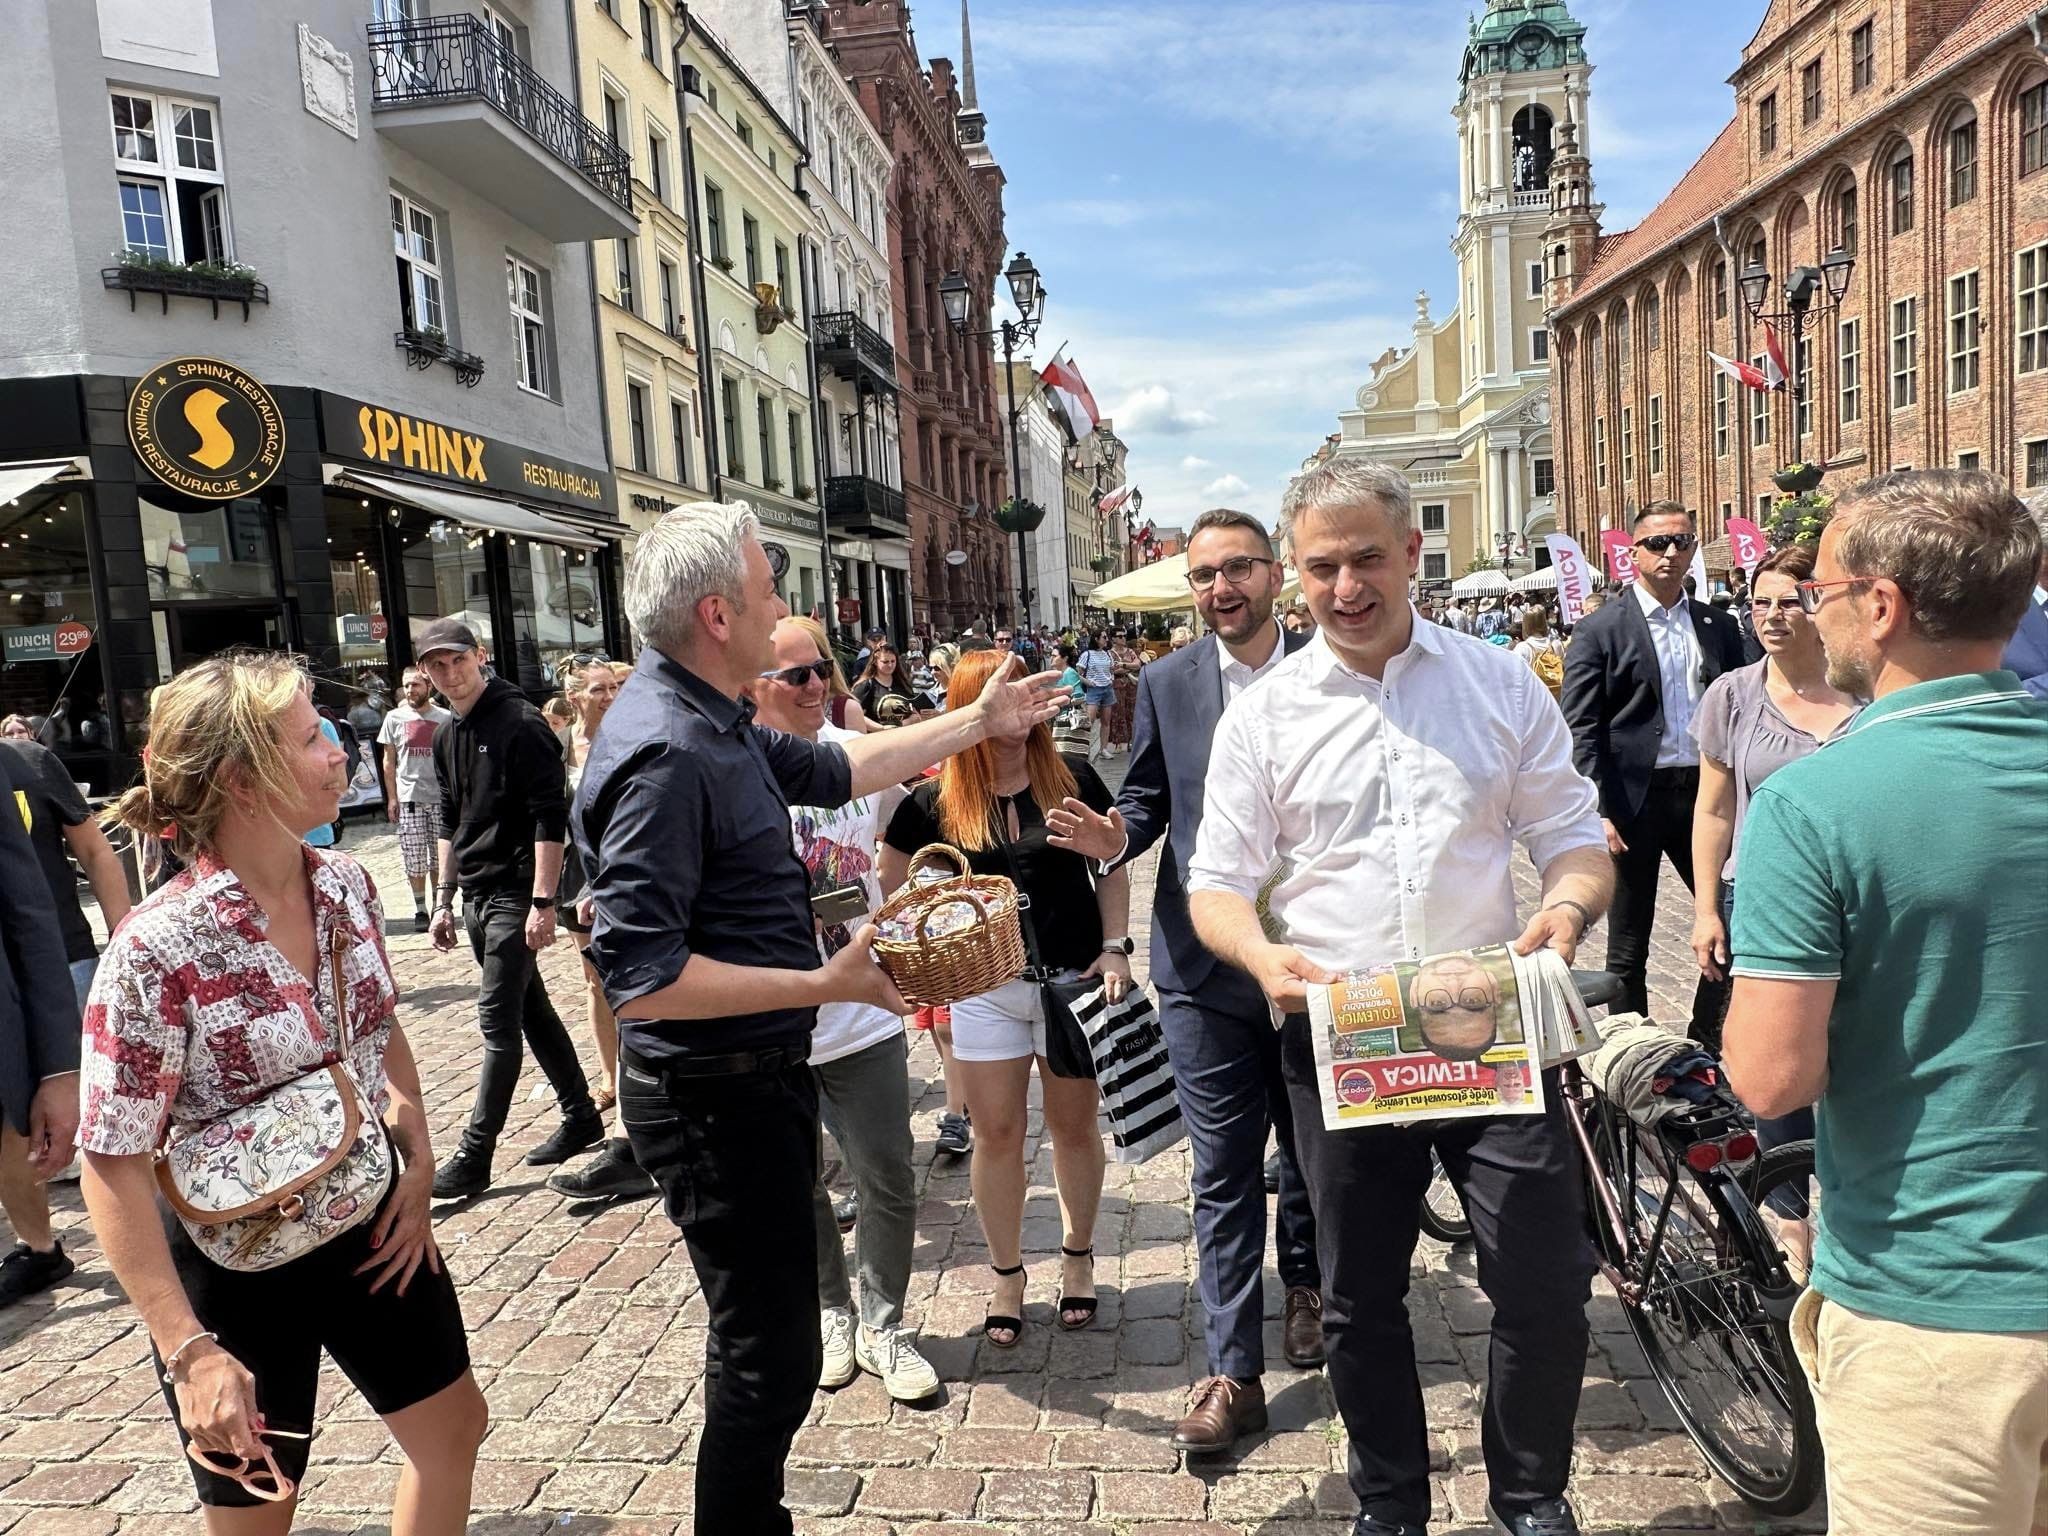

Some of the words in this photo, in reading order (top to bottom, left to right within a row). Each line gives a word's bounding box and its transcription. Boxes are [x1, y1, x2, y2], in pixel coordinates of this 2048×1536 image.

[135, 389, 154, 441] SPHINX
[177, 363, 234, 382] SPHINX
[234, 376, 279, 467] RESTAURACJE
[358, 405, 488, 483] SPHINX
[142, 443, 241, 493] RESTAURACJE
[522, 461, 602, 500] RESTAURACJA
[8, 633, 51, 649] LUNCH
[346, 622, 369, 633] LUNCH
[1337, 1009, 1380, 1025] LEWICA
[1382, 1007, 1398, 1020] TO
[1382, 1060, 1478, 1087] LEWICA
